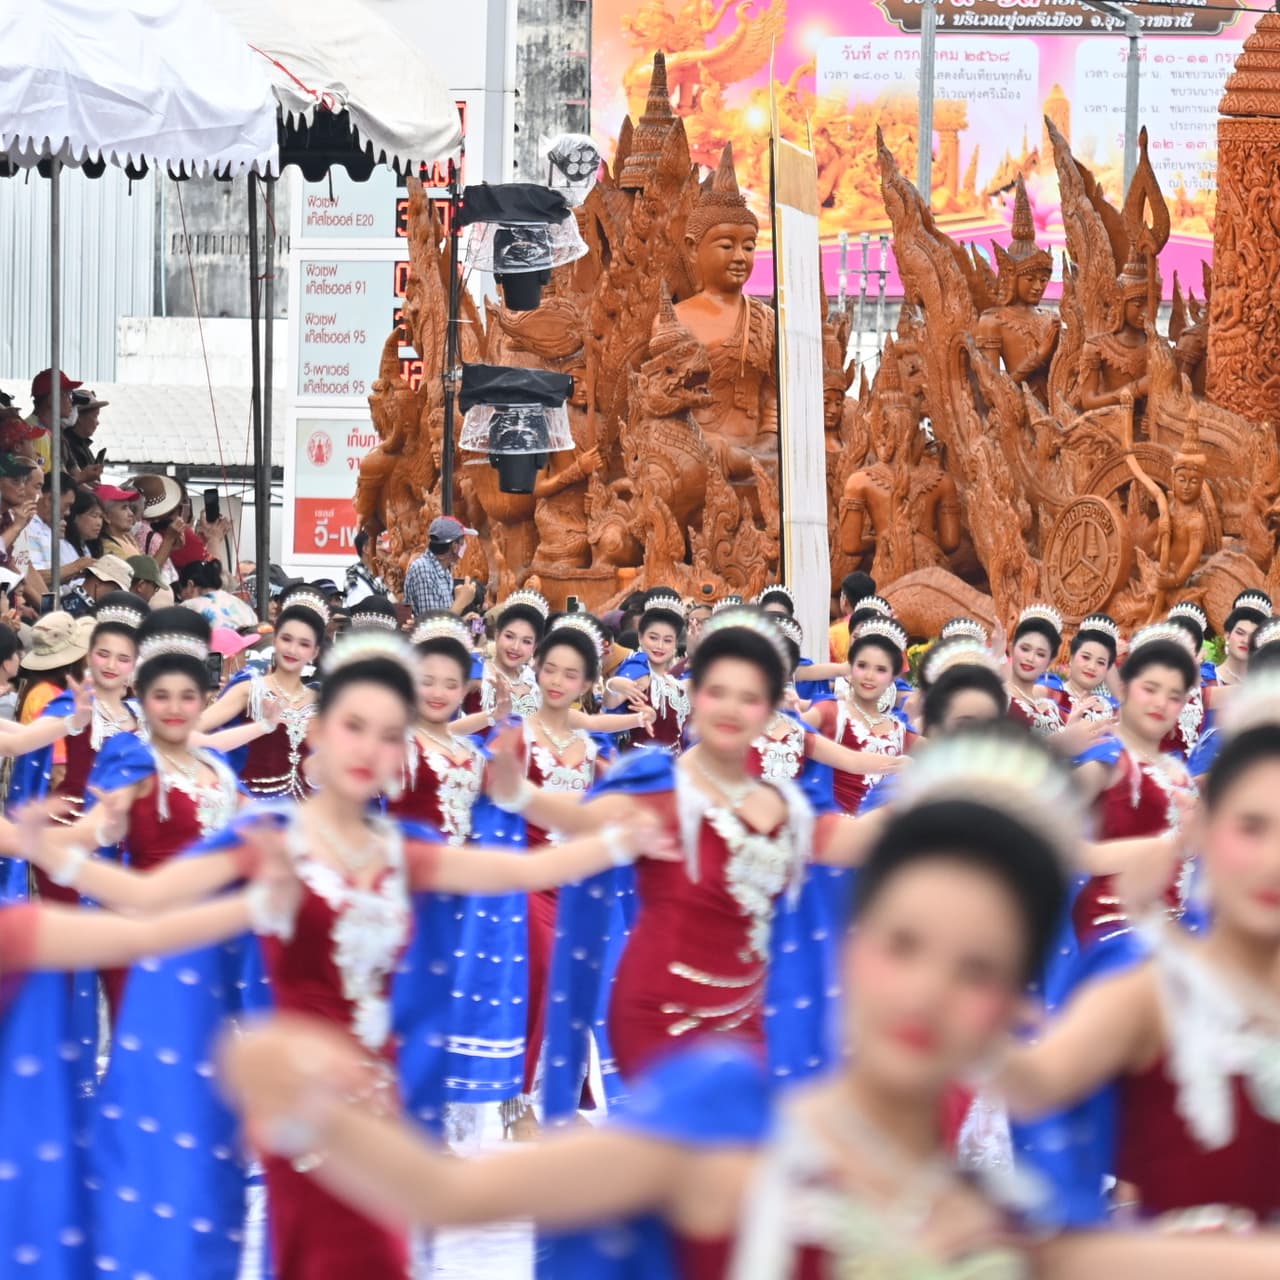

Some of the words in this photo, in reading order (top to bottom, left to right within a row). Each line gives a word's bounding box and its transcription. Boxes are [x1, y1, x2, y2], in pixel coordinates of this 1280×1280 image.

[356, 213, 374, 226] E20
[354, 282, 367, 295] 91
[353, 330, 366, 344] 95
[352, 380, 365, 394] 95
